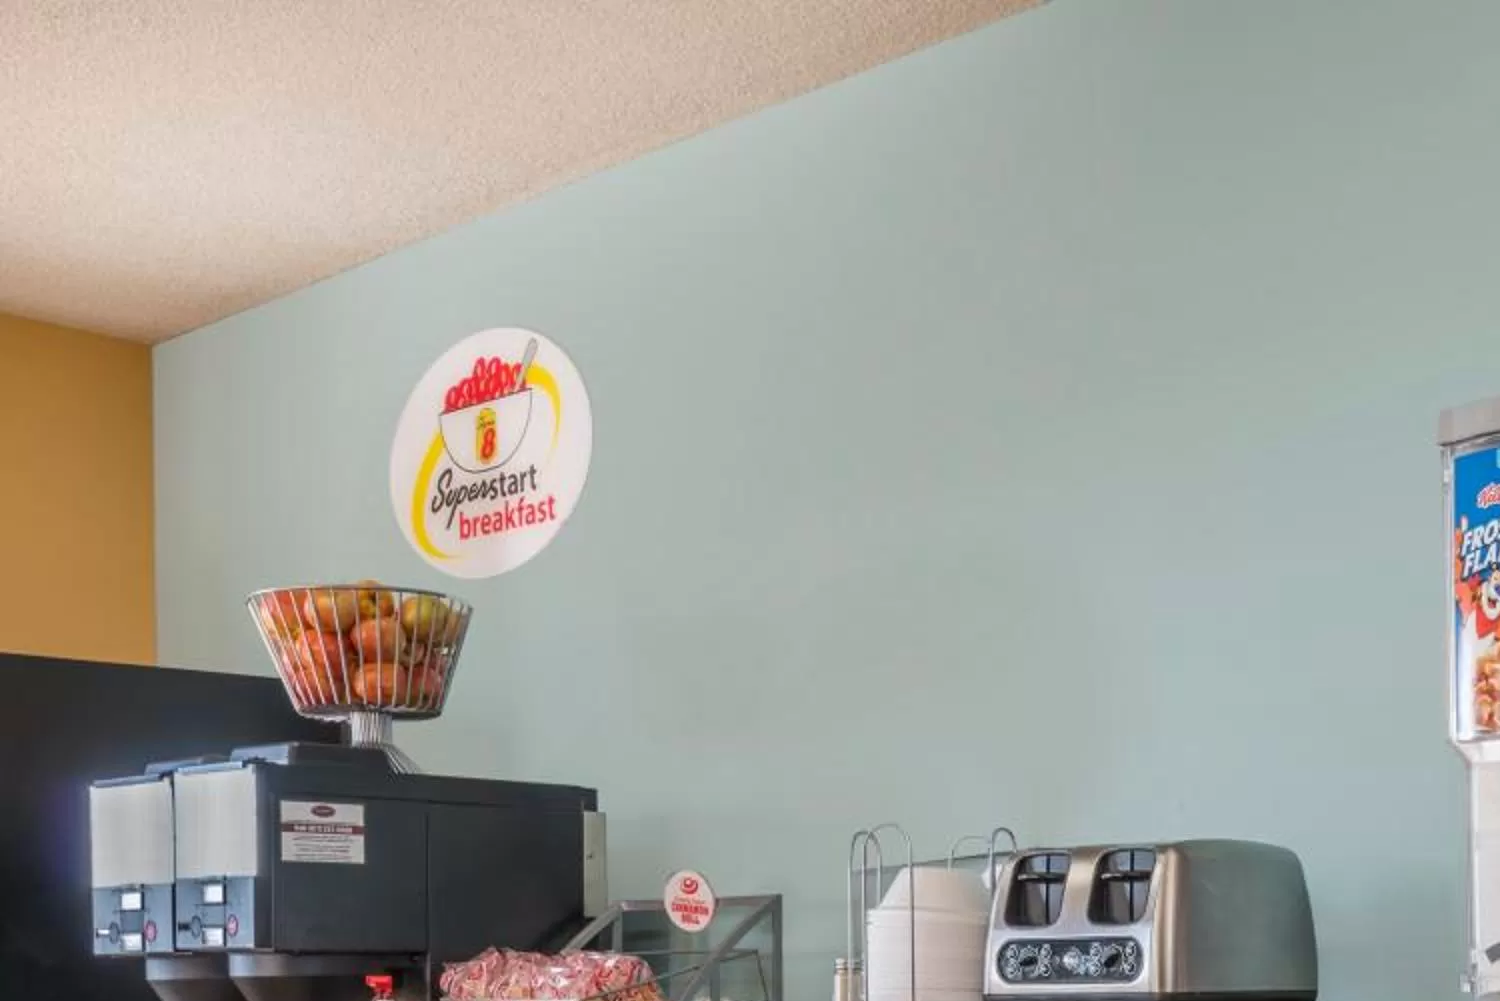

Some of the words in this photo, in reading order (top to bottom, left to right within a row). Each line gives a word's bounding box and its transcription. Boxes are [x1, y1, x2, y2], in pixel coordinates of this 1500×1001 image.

[481, 427, 495, 459] 8
[431, 464, 537, 530] Superstart
[459, 495, 556, 540] breakfast
